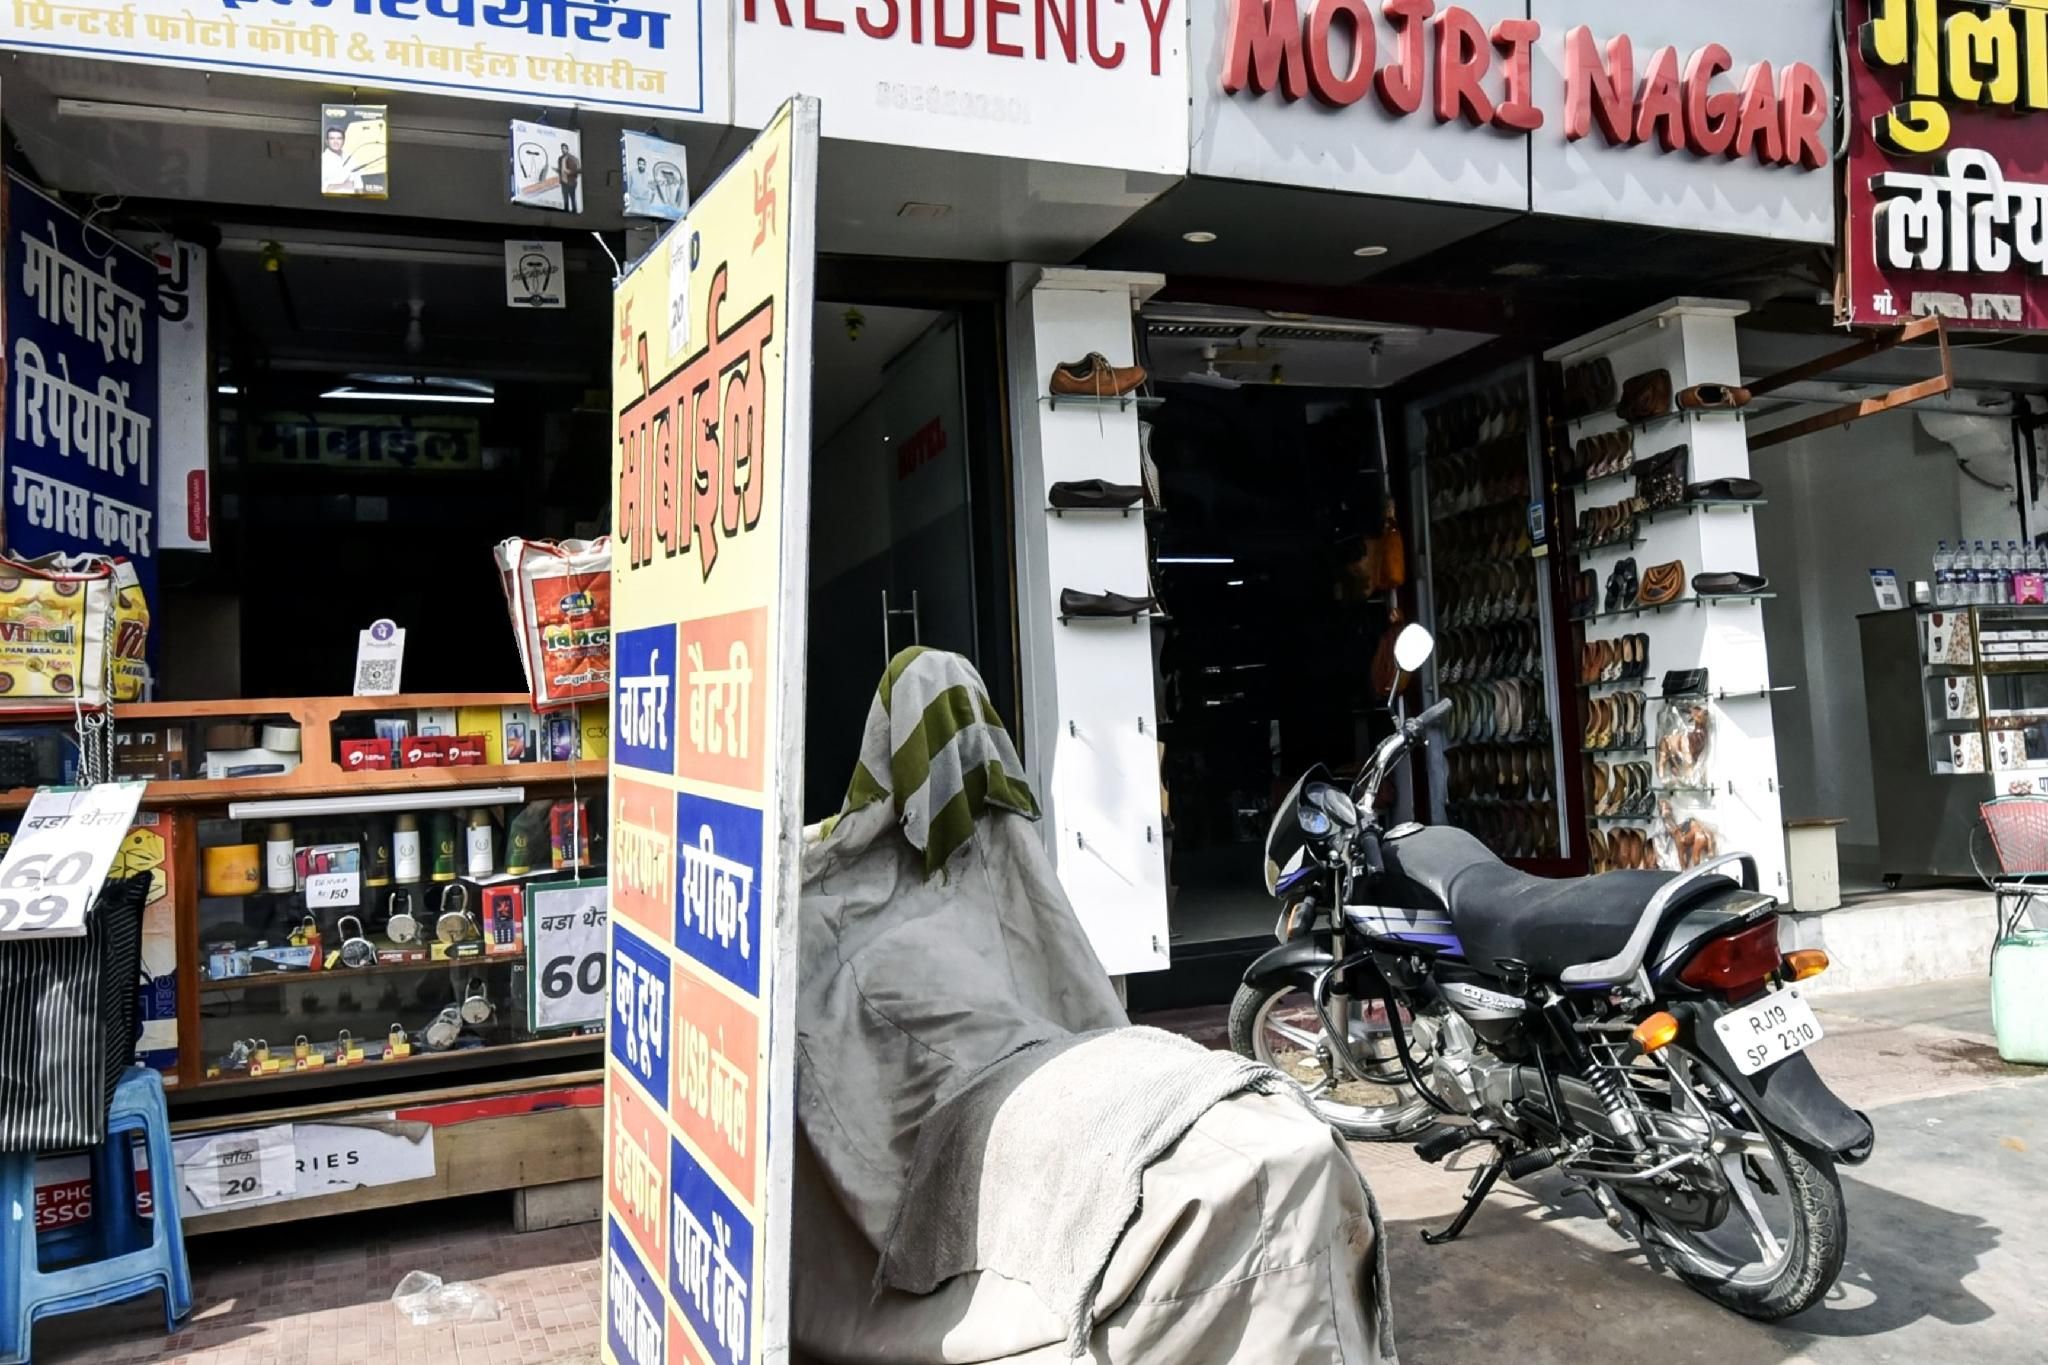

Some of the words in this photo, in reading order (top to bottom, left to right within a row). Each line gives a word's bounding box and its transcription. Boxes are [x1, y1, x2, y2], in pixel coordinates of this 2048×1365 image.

[144, 9, 238, 49] फोटो
[246, 18, 338, 60] कॉपी
[346, 31, 374, 63] &
[384, 33, 518, 79] मोबाईल
[353, 0, 671, 49] रिपयरिंग
[742, 0, 1172, 76] DENCY
[1221, 0, 1543, 131] MOJRI
[1565, 25, 1827, 170] NAGAR
[21, 219, 146, 366] मोबाईल
[14, 337, 151, 487] रिपेयरिंग
[619, 260, 773, 583] मोबाईल
[11, 465, 91, 540] ग्लास
[93, 493, 152, 558] कवर
[619, 648, 669, 751] चार्जर
[329, 888, 349, 900] 150
[682, 824, 753, 960] स्पीकर
[541, 952, 608, 999] 60
[1747, 1044, 1768, 1067] SP
[1778, 1023, 1814, 1051] 2310
[1749, 1005, 1787, 1035] RJ19
[679, 1016, 709, 1119] USB
[225, 1177, 257, 1196] 20
